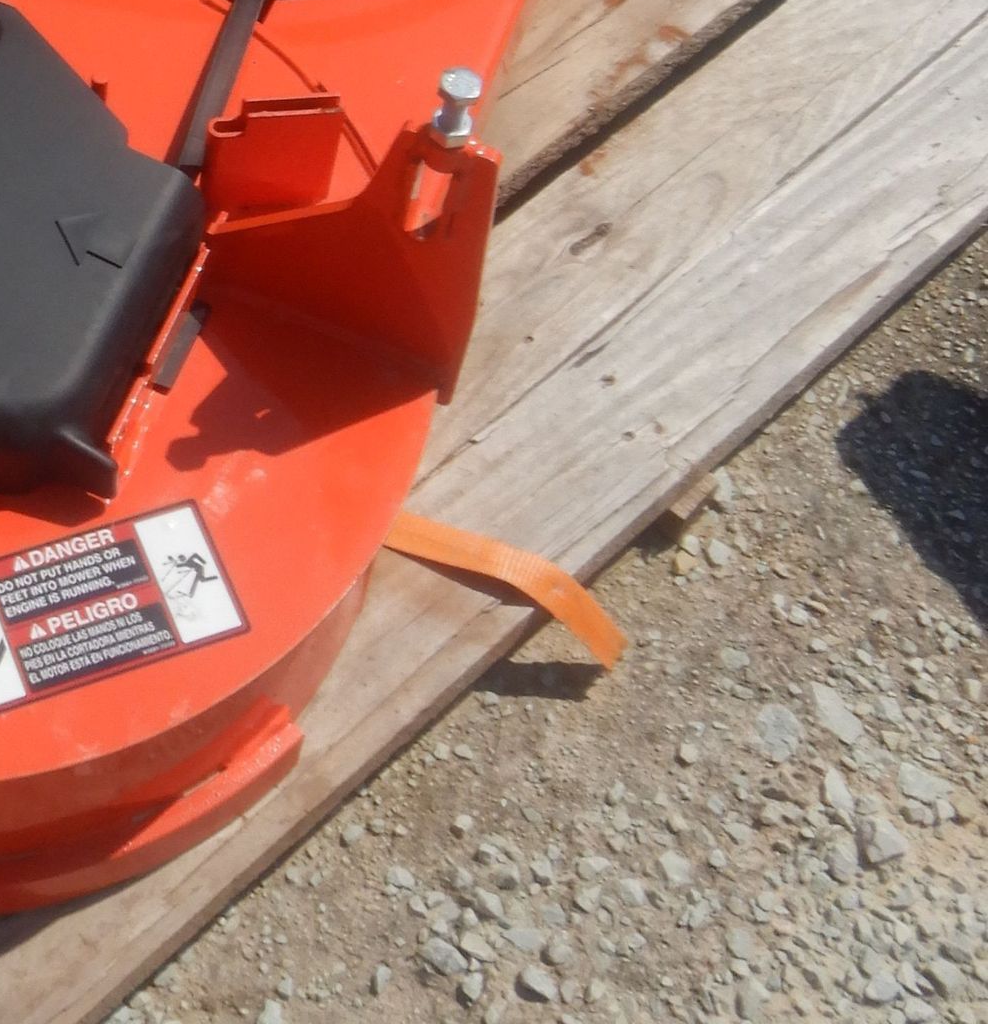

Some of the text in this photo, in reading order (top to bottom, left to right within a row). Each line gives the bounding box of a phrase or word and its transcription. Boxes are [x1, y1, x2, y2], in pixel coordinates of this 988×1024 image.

[15, 573, 39, 587] NOT
[40, 566, 61, 579] PUT
[64, 552, 102, 573] HANDS
[104, 547, 120, 559] OR
[30, 529, 114, 567] DANGER
[2, 590, 28, 605] FEET
[31, 581, 57, 596] INTO
[59, 567, 101, 587] MOWER
[103, 556, 135, 573] WHEN
[5, 597, 47, 618] ENGINE
[49, 592, 60, 603] IS
[63, 577, 114, 600] RUNNING.
[48, 593, 137, 633] PELIGRO
[19, 647, 32, 658] NO
[72, 629, 88, 642] LAS
[126, 612, 142, 625] LOS
[25, 622, 155, 670] PIES EN LA CORTADORA MIENTRAS
[29, 673, 41, 684] EL
[41, 662, 70, 680] MOTOR
[92, 653, 104, 663] EN
